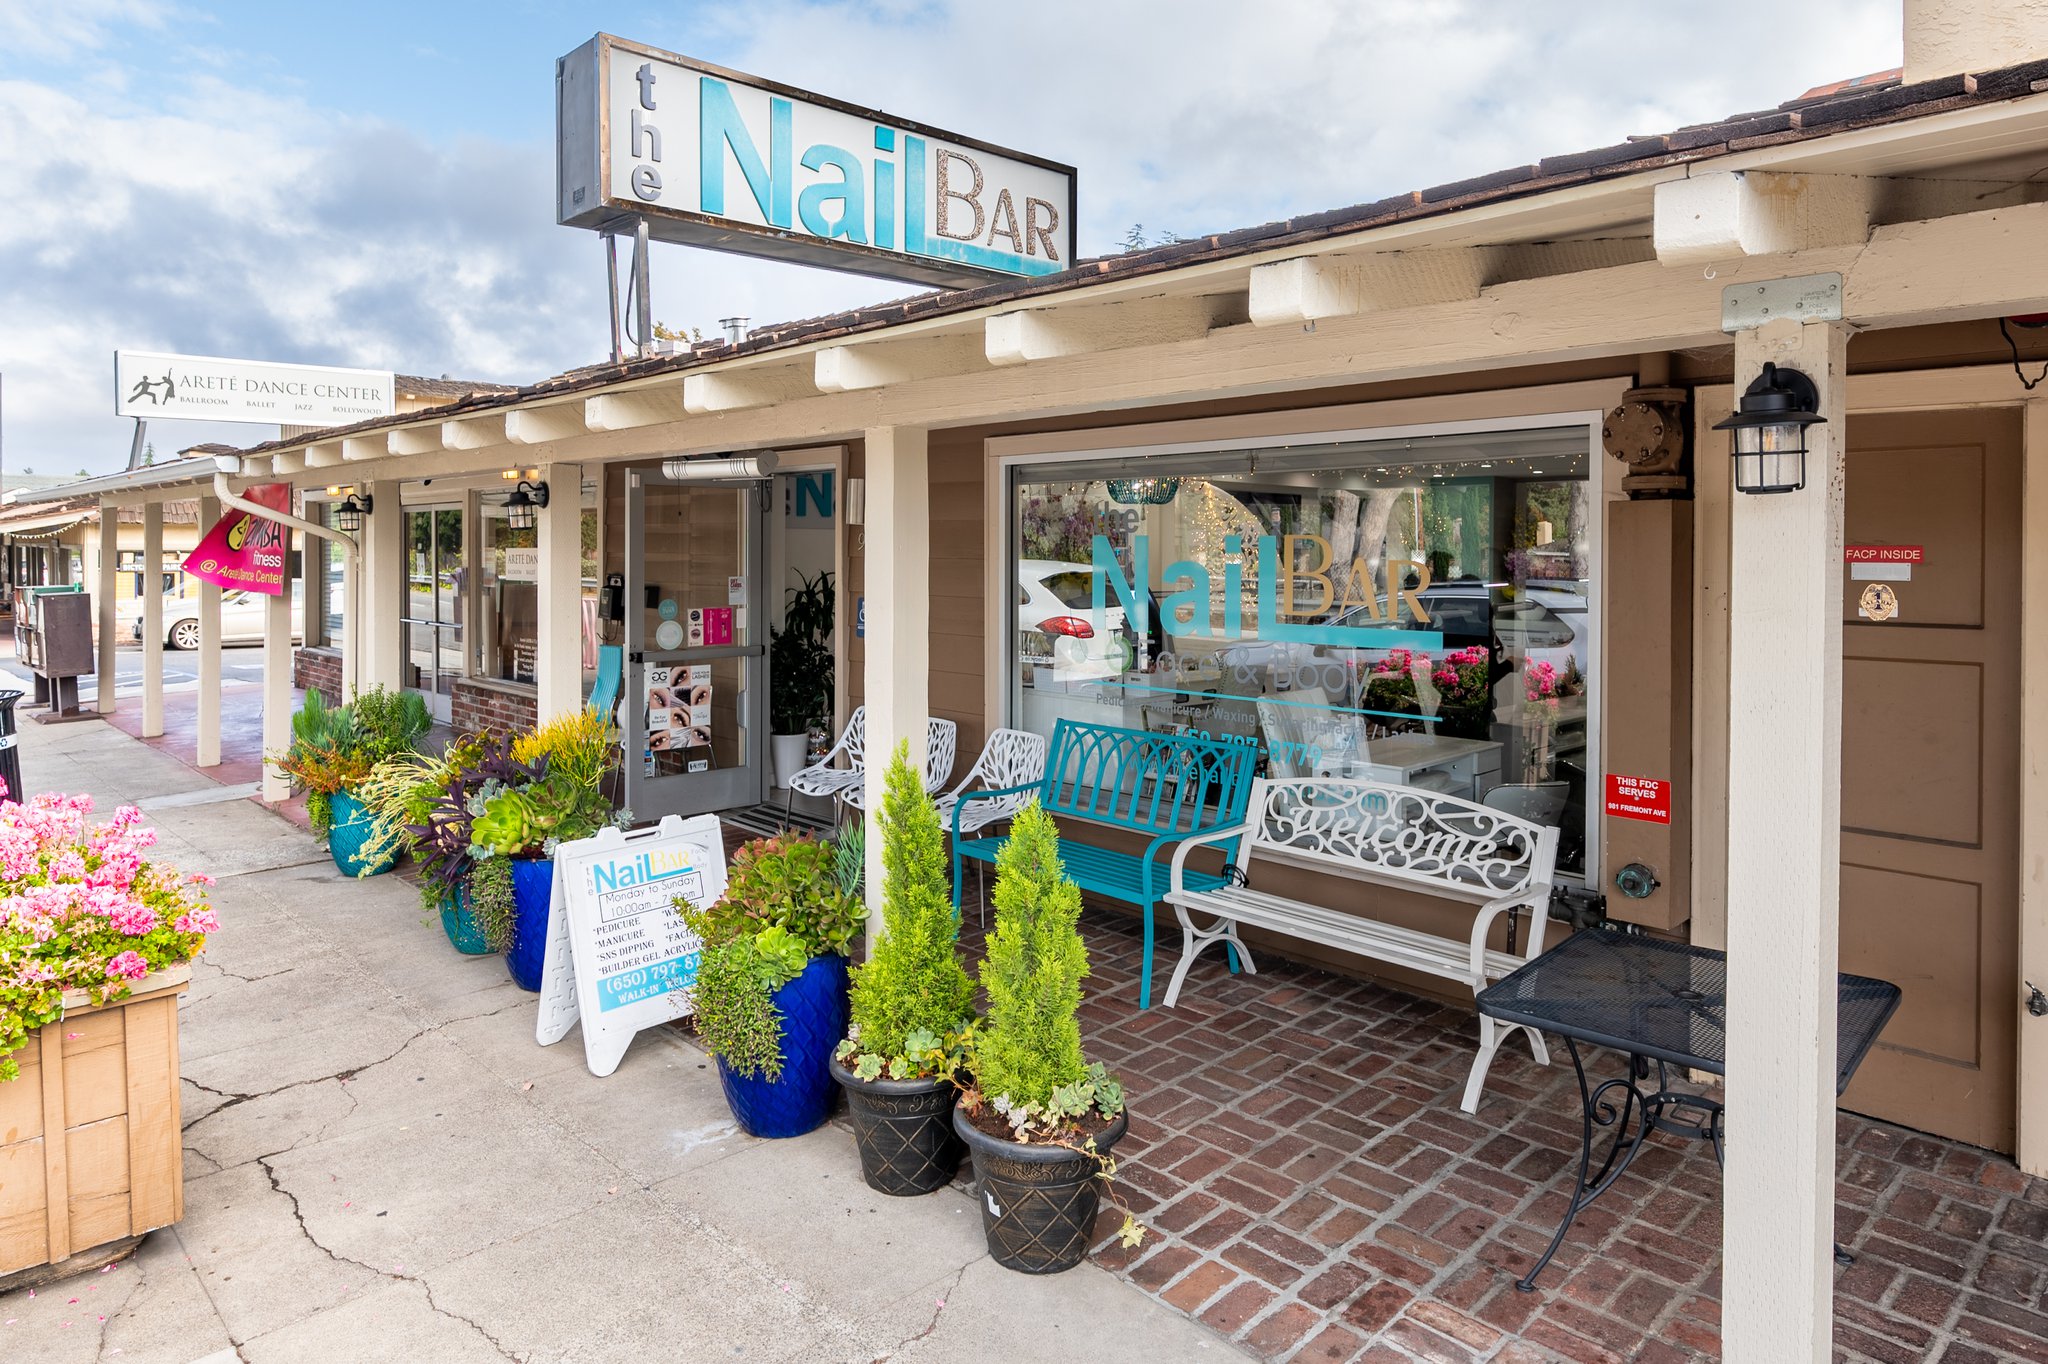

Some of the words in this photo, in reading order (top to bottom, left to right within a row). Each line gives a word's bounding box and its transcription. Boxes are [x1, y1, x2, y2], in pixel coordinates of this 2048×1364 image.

[631, 62, 662, 201] the
[180, 375, 237, 391] ARETÉ
[246, 379, 307, 396] DANCE
[313, 384, 382, 401] CENTER
[180, 396, 228, 406] BALLROOM
[246, 400, 276, 409] BALLET
[294, 403, 313, 411] JAZZ
[332, 406, 382, 415] BOLLYWOOD
[1094, 501, 1139, 533] the
[252, 550, 282, 568] fitness
[526, 554, 538, 565] DAN
[1846, 549, 1877, 559] FACP
[1880, 550, 1921, 560] INSIDE
[200, 559, 217, 574] @
[255, 569, 283, 585] Center
[1212, 707, 1255, 726] Waxing
[1616, 776, 1637, 786] THIS
[1639, 780, 1659, 790] FDC
[1619, 786, 1656, 799] SERVES
[1620, 804, 1653, 815] FREMONT
[1653, 809, 1667, 817] AVE
[606, 887, 645, 904] Monday
[649, 886, 659, 894] to
[661, 877, 695, 891] Sunday
[611, 901, 652, 917] 10:00am
[619, 940, 655, 957] DIPPING
[642, 952, 661, 963] GEL
[606, 969, 647, 994] (650)
[684, 955, 702, 973] 87
[618, 984, 659, 1005] WALK-IN
[665, 974, 698, 990] WELCO
